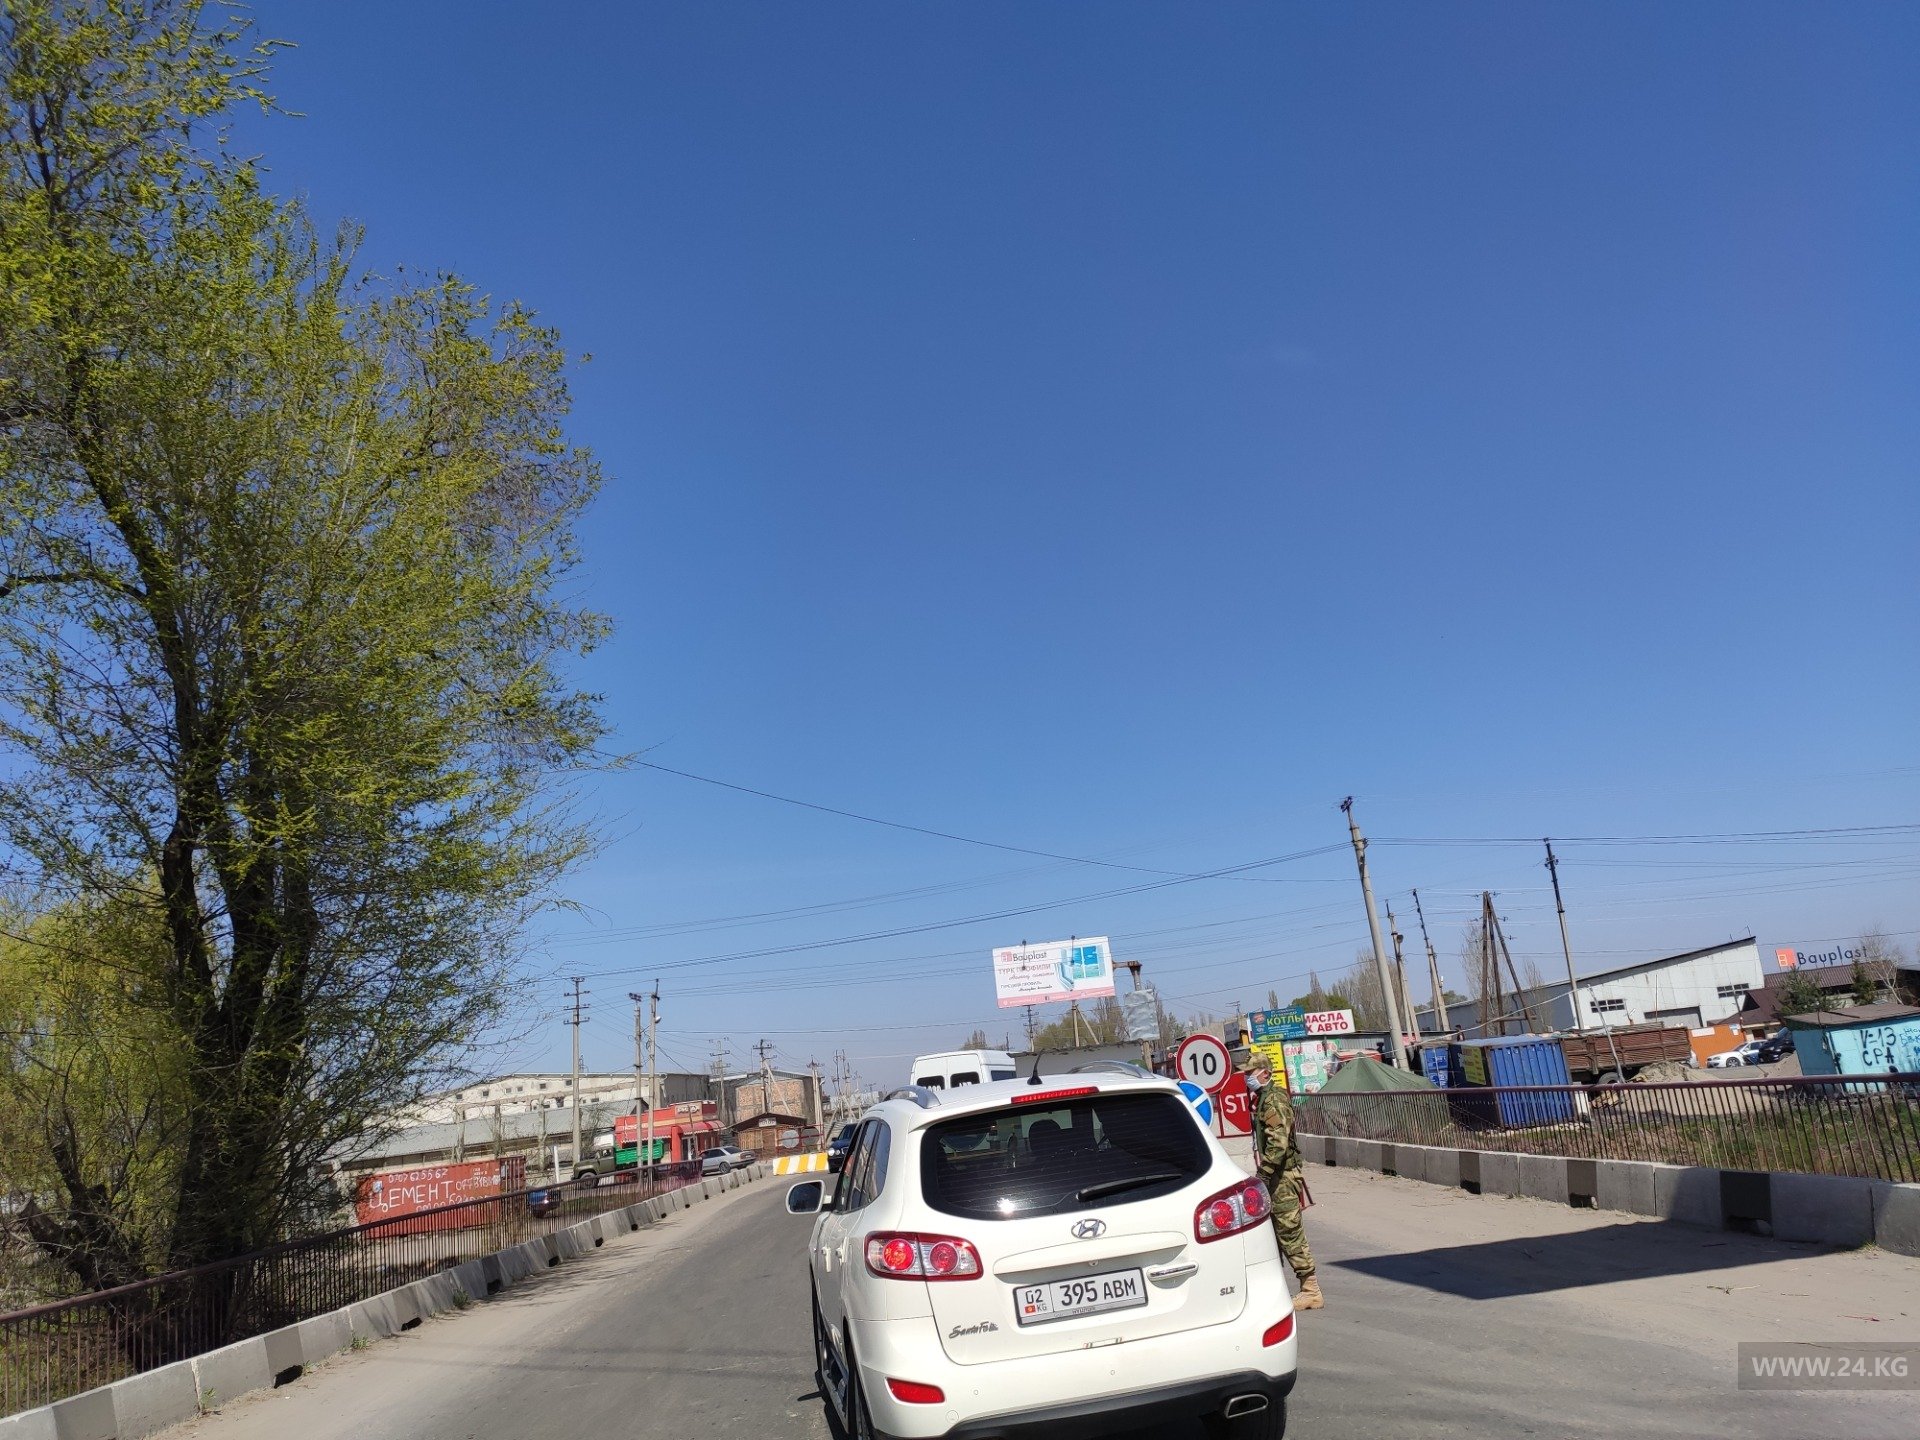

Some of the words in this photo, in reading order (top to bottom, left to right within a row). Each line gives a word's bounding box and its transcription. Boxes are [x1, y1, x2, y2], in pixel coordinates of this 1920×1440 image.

[1013, 950, 1047, 962] Bauplast
[1797, 945, 1867, 966] Bauplast
[1266, 1014, 1304, 1027] КОТЛЫ
[1317, 1021, 1348, 1033] АВТО
[1189, 1052, 1217, 1076] 10
[369, 1181, 453, 1212] ЦЕМЕНТ
[1060, 1280, 1098, 1307] 395
[1103, 1277, 1137, 1300] ABM
[1219, 1285, 1236, 1297] SLX
[1037, 1303, 1047, 1312] KG
